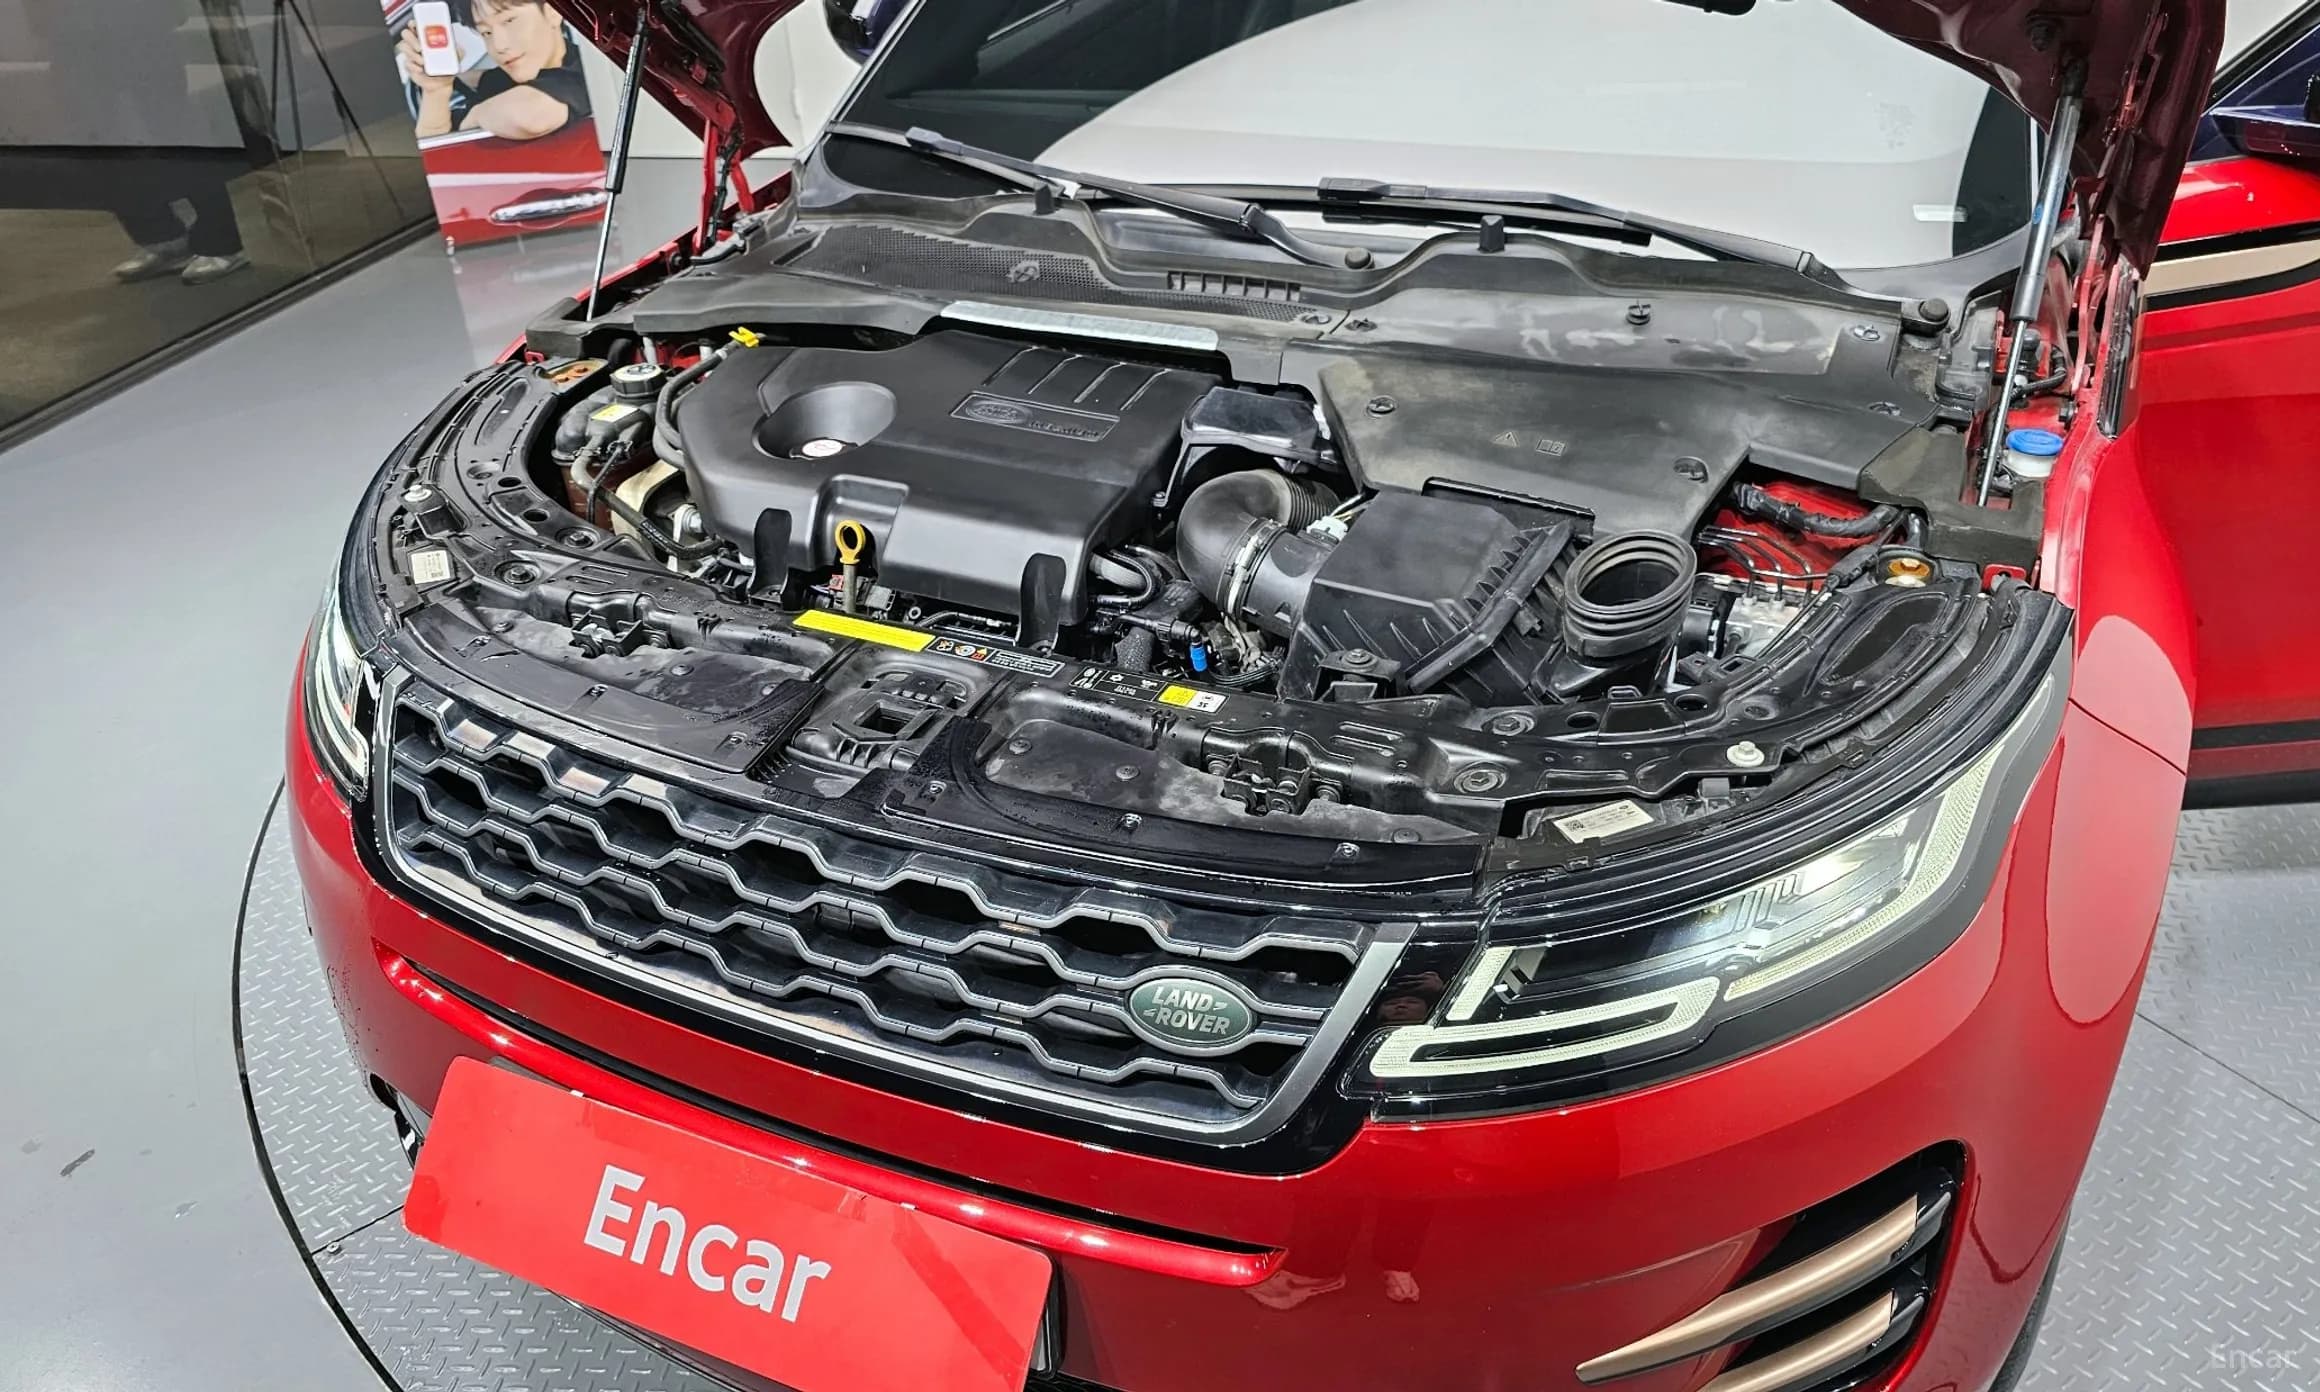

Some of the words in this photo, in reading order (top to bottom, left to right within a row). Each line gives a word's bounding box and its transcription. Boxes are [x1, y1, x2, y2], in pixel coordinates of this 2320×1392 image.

[1151, 986, 1214, 1012] LAND
[1154, 1007, 1231, 1035] ROVER
[583, 1164, 833, 1323] Encar
